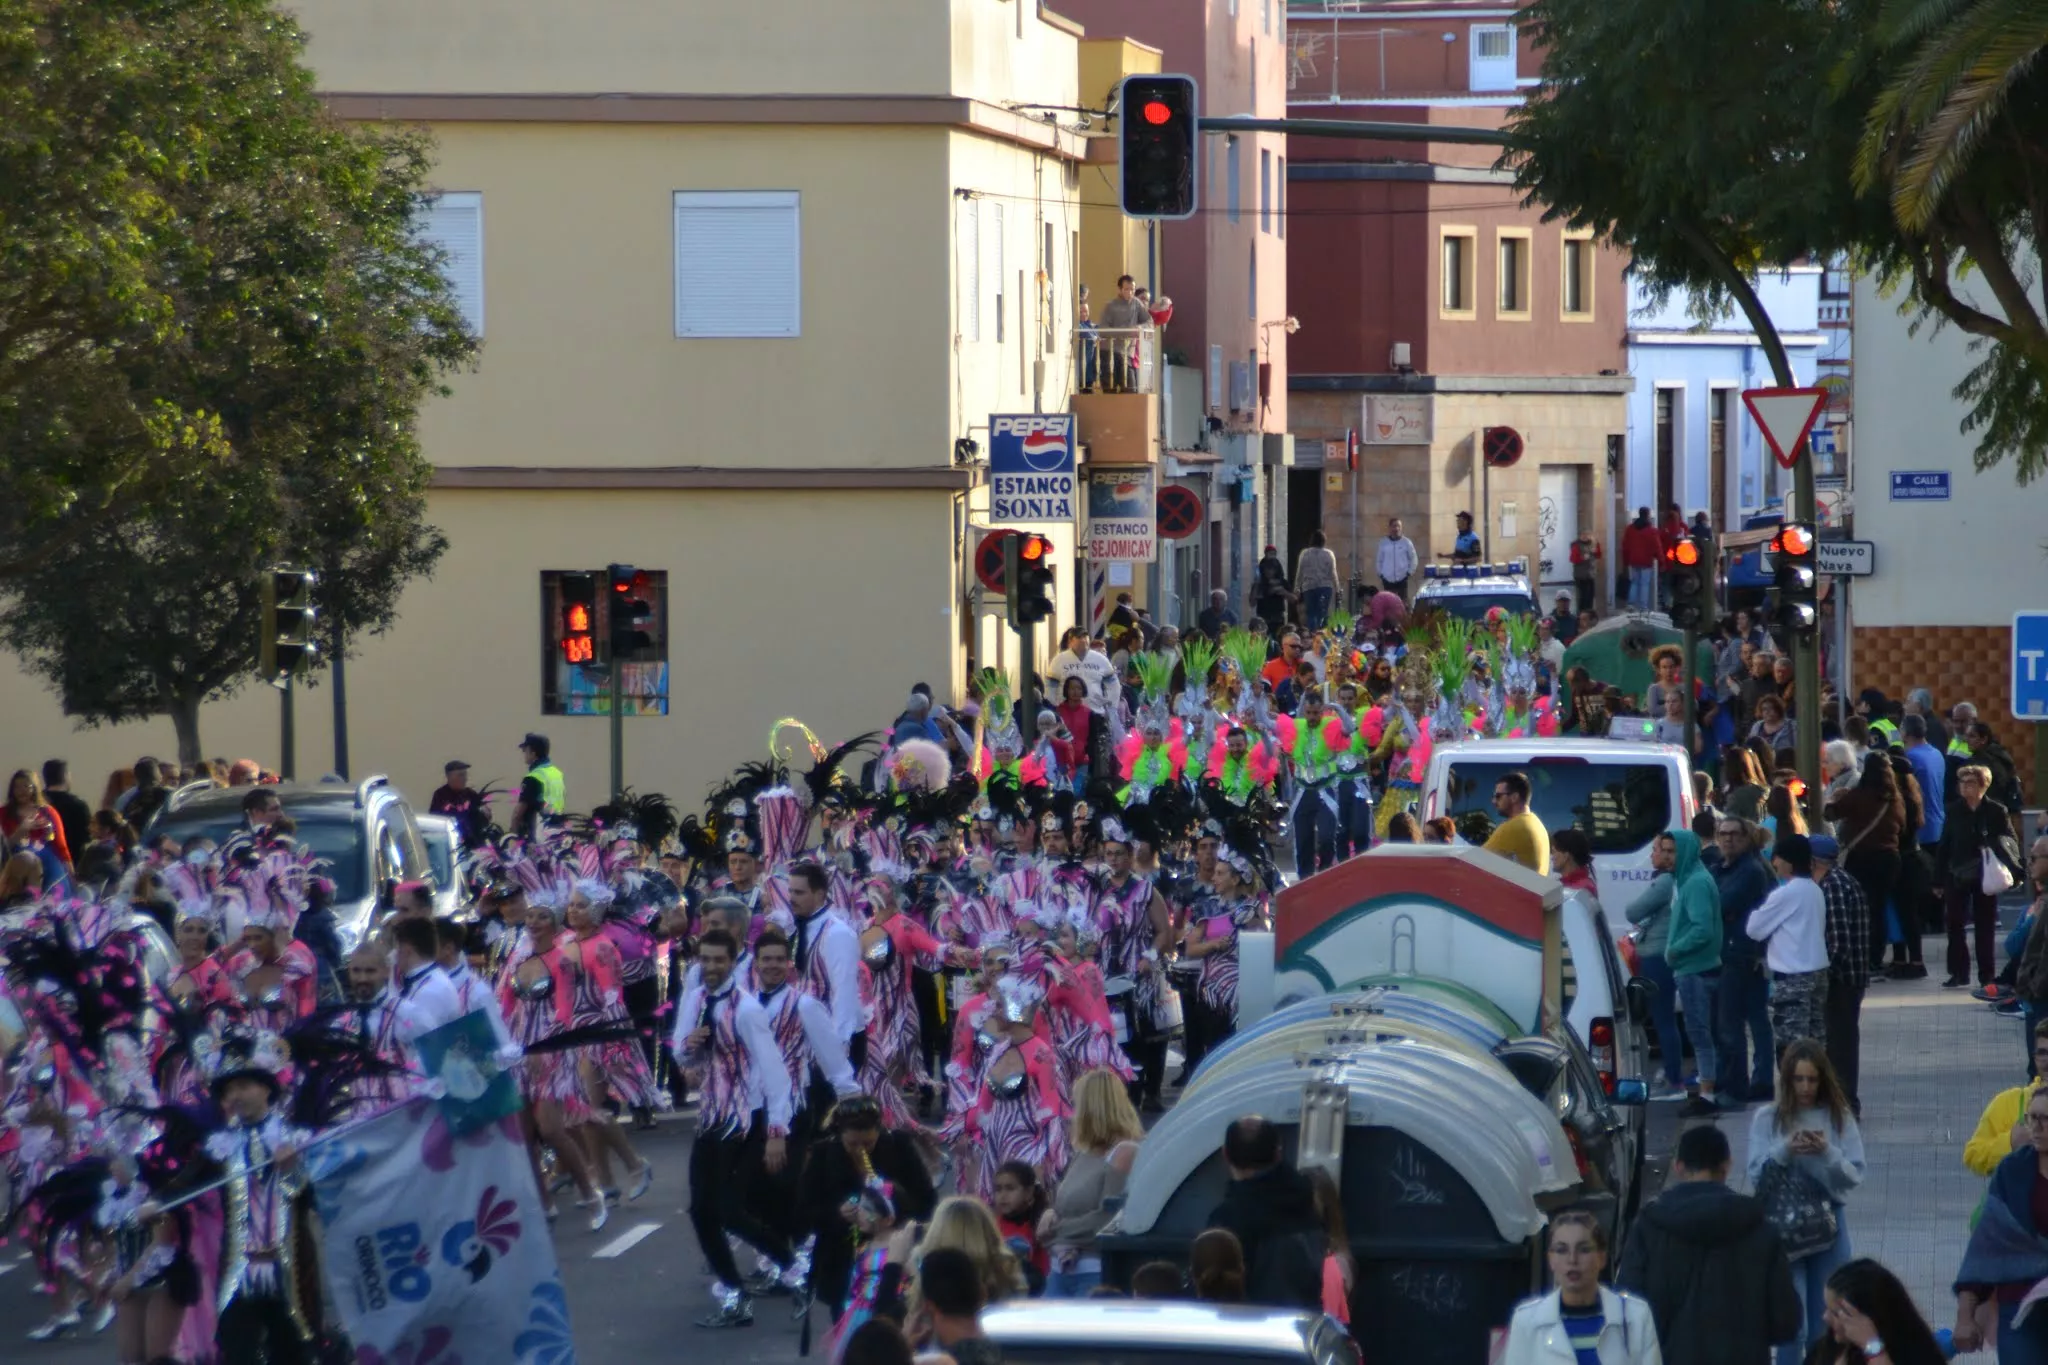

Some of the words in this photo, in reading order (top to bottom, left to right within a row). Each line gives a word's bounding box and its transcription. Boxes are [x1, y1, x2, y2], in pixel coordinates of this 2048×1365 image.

[993, 417, 1071, 437] PEPSI
[995, 476, 1072, 495] ESTANCO
[1093, 472, 1149, 486] PEPSI
[995, 498, 1072, 518] SONIA
[1094, 523, 1148, 536] ESTANCO
[1820, 545, 1866, 557] Nuevo
[1817, 560, 1853, 572] Nava
[2020, 650, 2048, 681] T
[1611, 869, 1618, 881] 9
[1621, 869, 1653, 881] PLAZ
